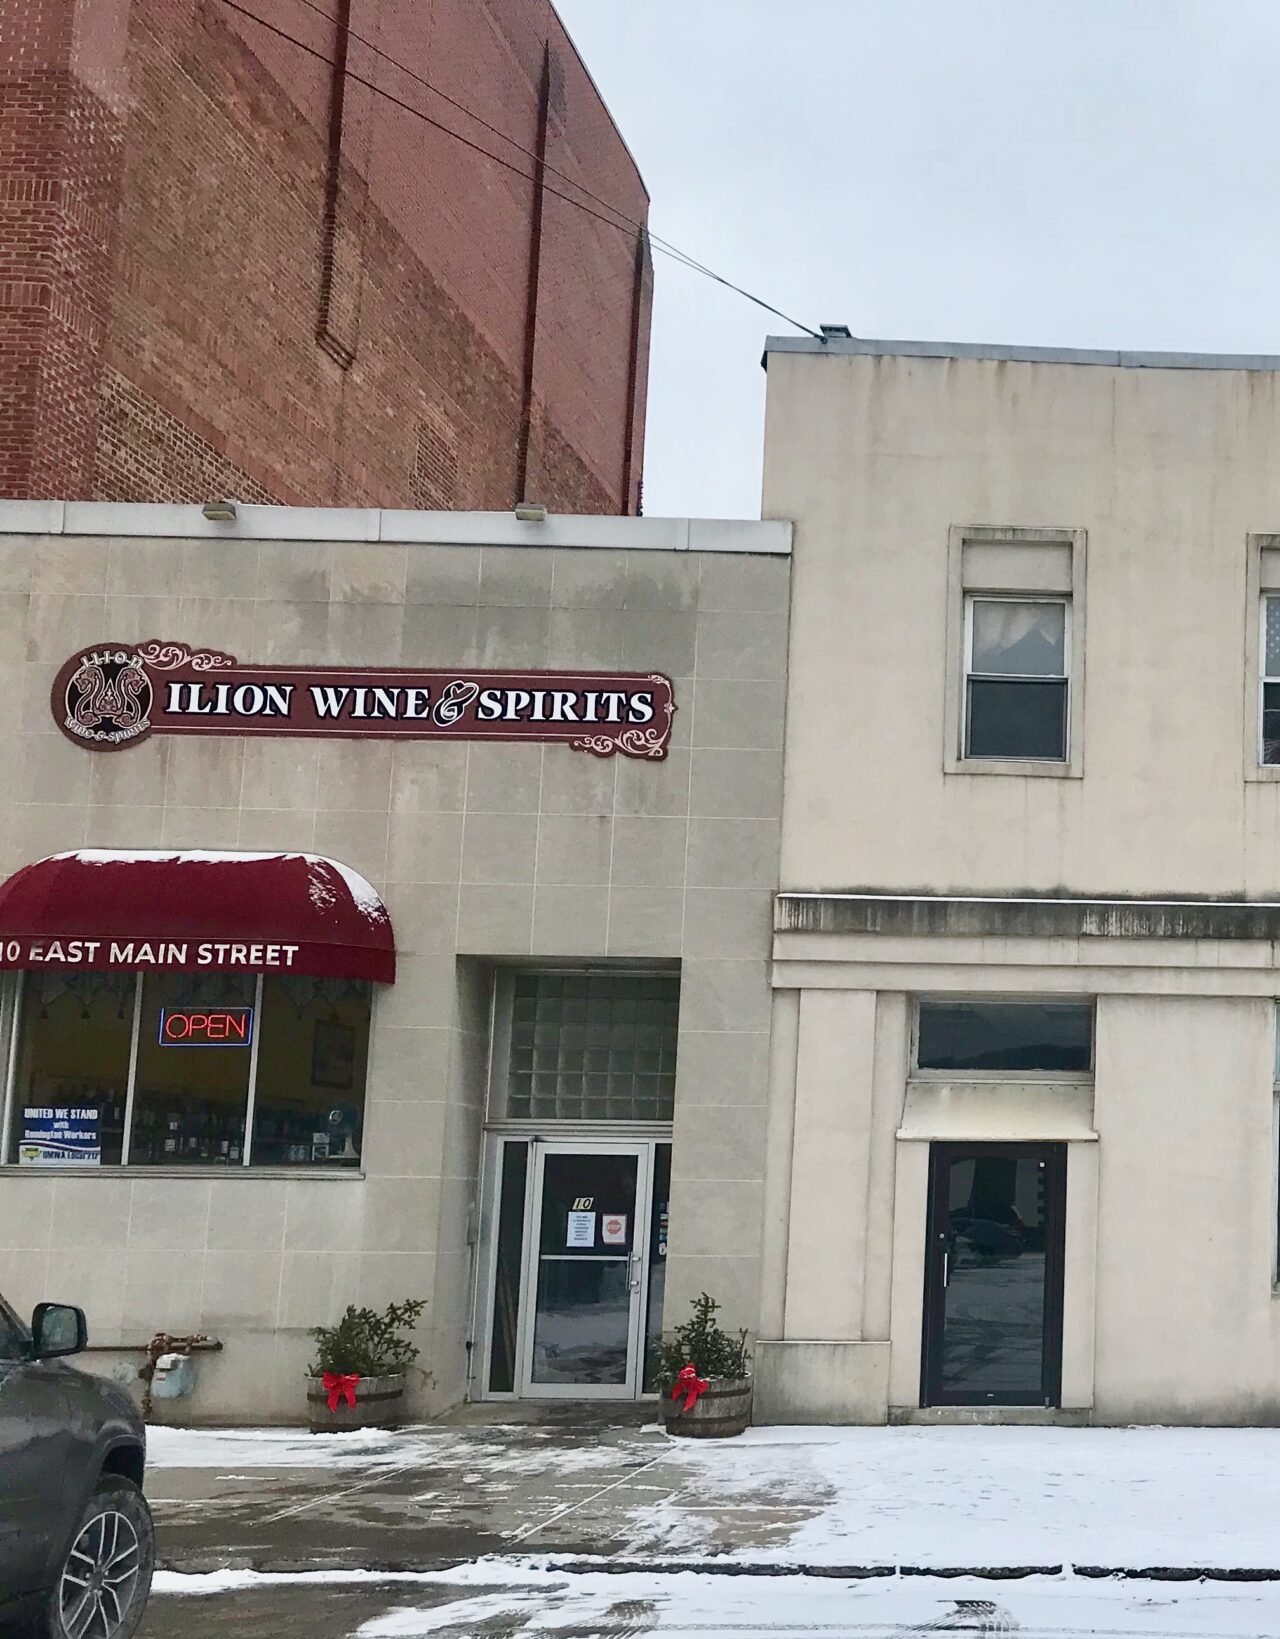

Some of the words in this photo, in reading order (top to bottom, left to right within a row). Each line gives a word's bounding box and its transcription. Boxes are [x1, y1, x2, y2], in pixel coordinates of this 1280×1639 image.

[166, 683, 294, 716] ILION
[309, 687, 430, 718] WINE
[433, 680, 479, 727] &
[477, 689, 654, 723] SPIRITS
[29, 941, 101, 962] EAST
[109, 943, 188, 964] MAIN
[197, 943, 299, 966] STREET
[165, 1014, 246, 1038] OPEN
[24, 1108, 53, 1119] UNITED
[55, 1108, 69, 1119] WE
[70, 1109, 98, 1119] STAND
[575, 1198, 592, 1209] 10
